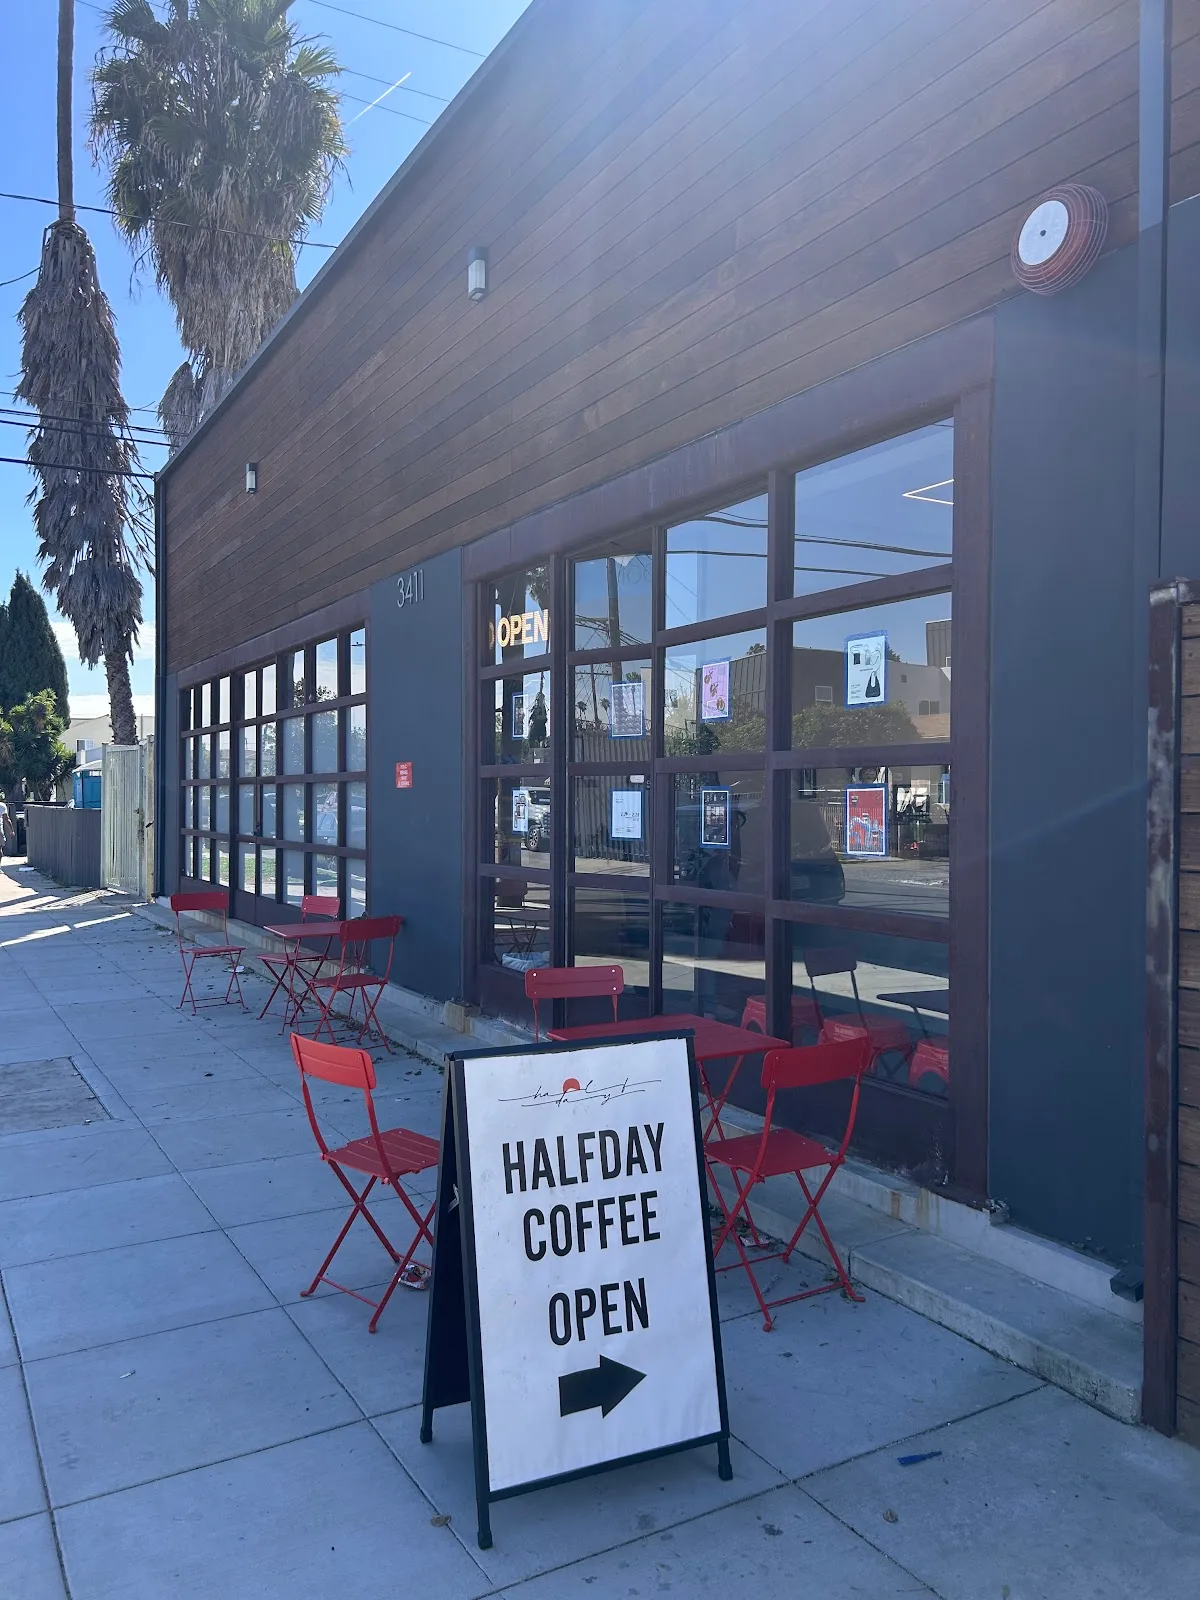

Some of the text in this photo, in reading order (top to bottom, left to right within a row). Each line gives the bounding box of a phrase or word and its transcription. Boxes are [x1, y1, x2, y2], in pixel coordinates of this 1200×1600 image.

[396, 569, 425, 608] 3411
[497, 609, 549, 648] OPEN
[502, 1122, 665, 1195] HALFDAY
[523, 1190, 661, 1262] COFFEE
[549, 1277, 650, 1346] OPEN
